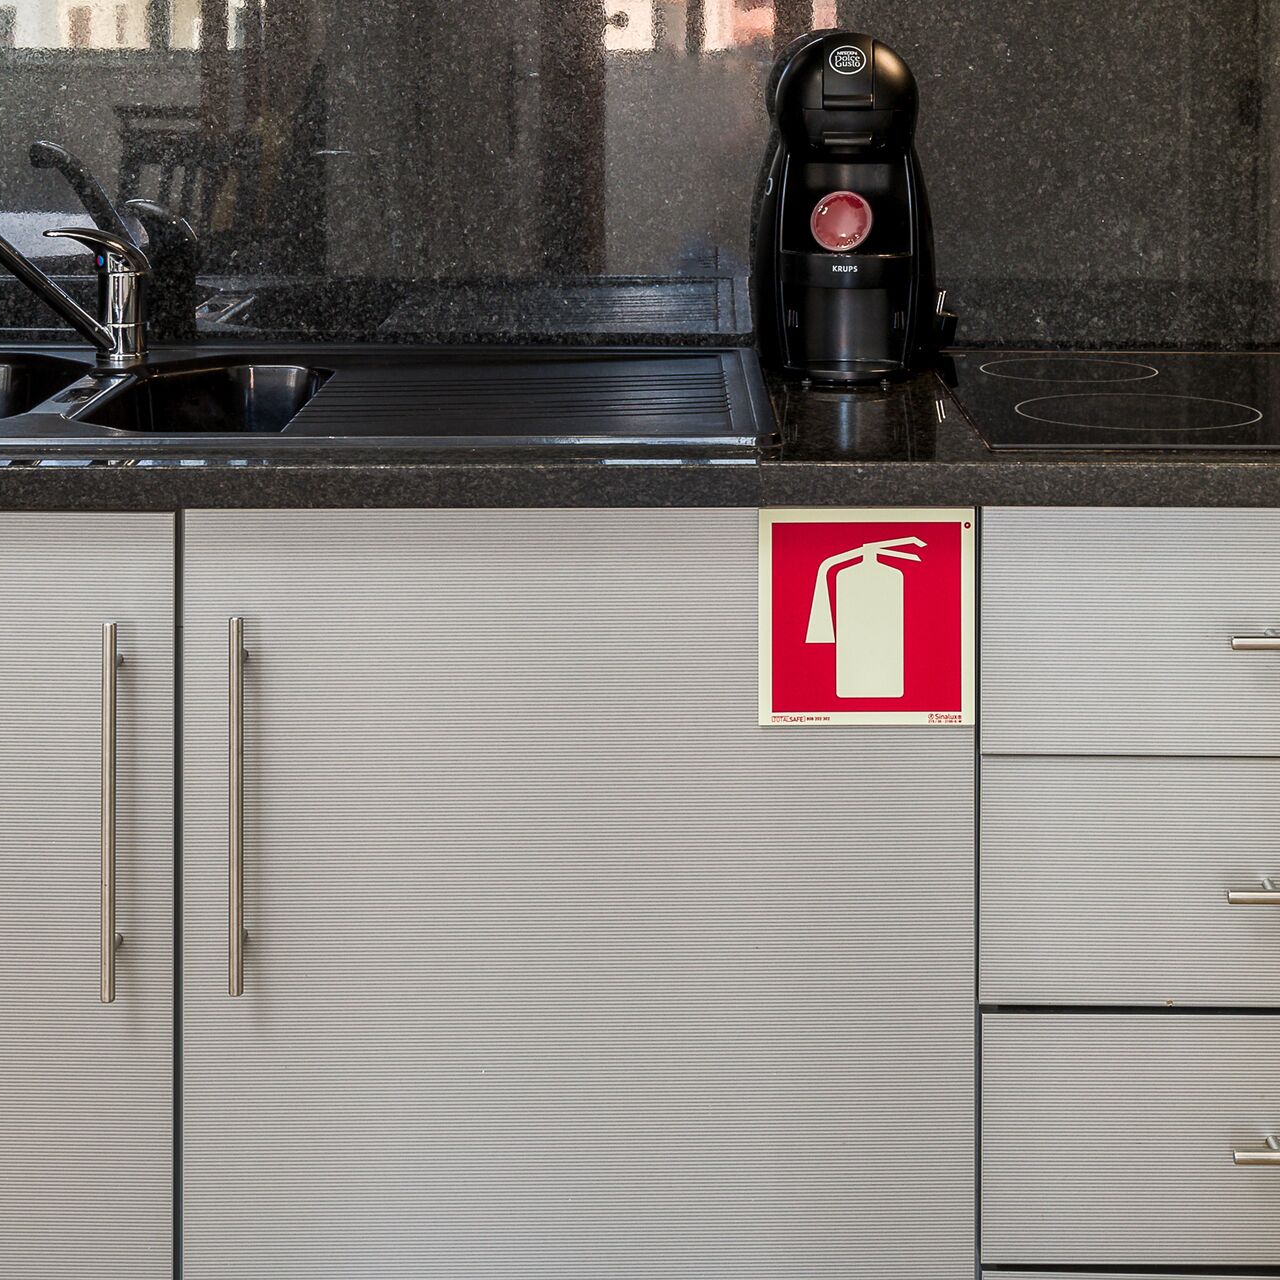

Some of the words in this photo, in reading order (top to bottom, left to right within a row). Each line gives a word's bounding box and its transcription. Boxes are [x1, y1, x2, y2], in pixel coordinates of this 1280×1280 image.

[835, 54, 861, 63] Dolce
[835, 60, 861, 68] Gusto
[832, 265, 858, 273] KRUPS
